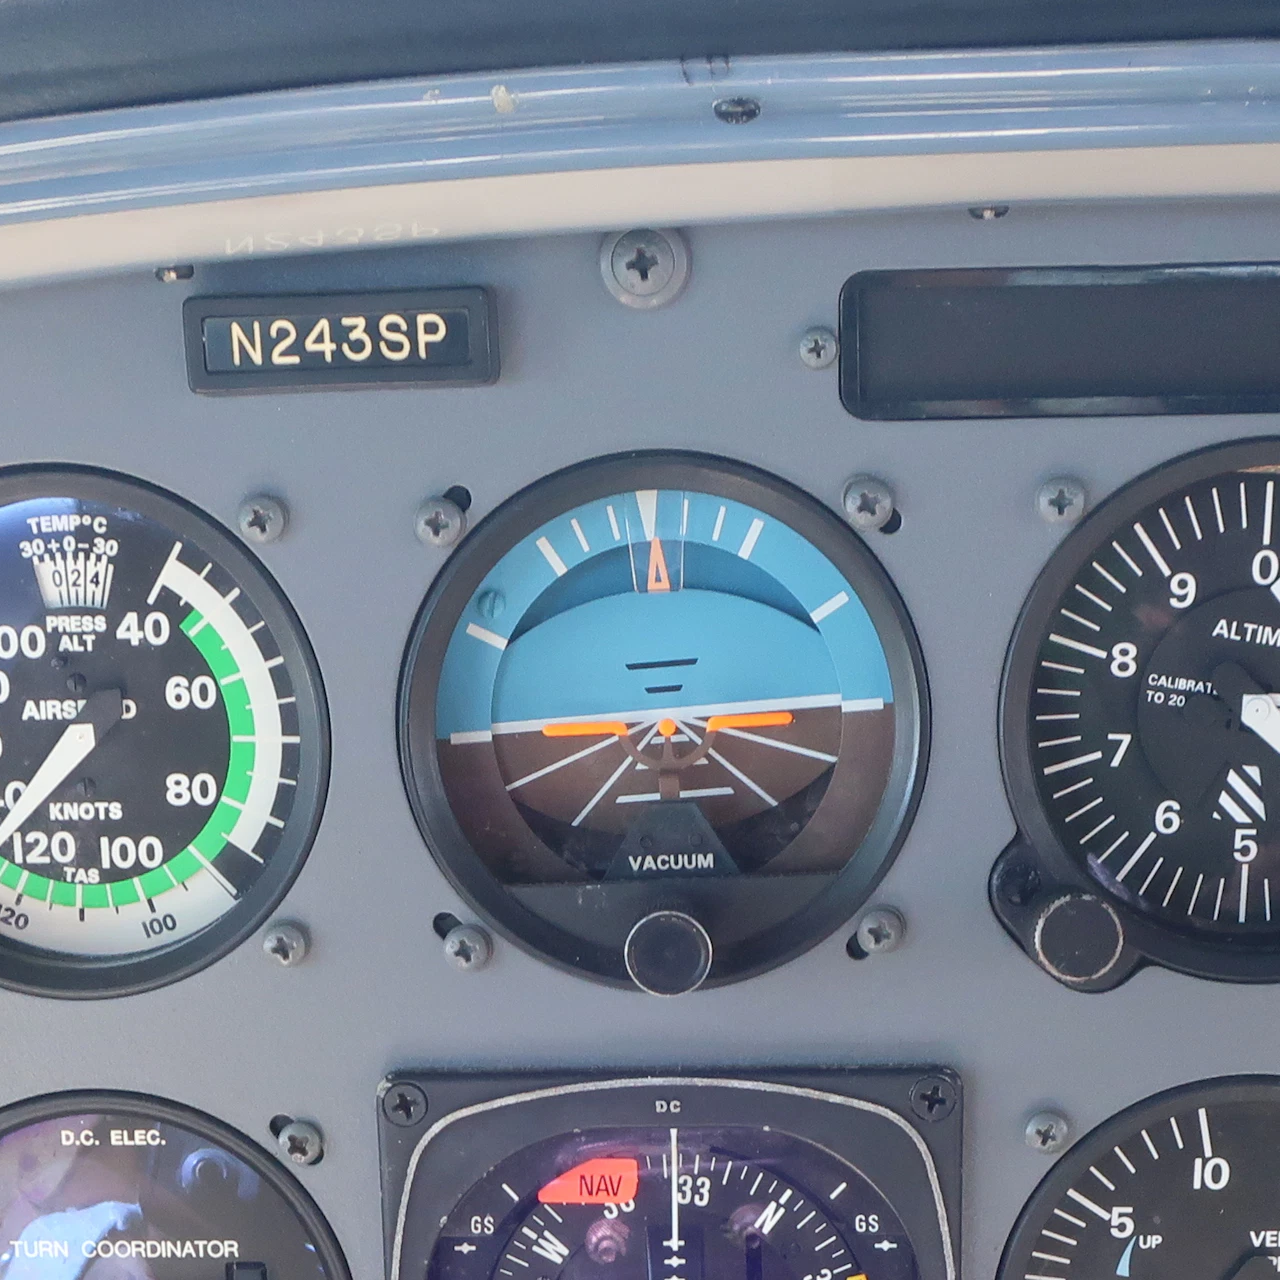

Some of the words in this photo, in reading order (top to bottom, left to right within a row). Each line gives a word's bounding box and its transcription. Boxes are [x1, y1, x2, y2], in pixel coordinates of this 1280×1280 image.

[231, 314, 446, 365] N243SP
[46, 615, 106, 632] PRESS
[116, 612, 169, 646] 40
[59, 635, 95, 651] ALT
[166, 676, 216, 709] 60
[166, 773, 216, 806] 80
[50, 802, 122, 820] KNOTS
[629, 853, 713, 871] VACUUM
[65, 867, 99, 883] TAS
[61, 1130, 99, 1145] D.C.
[111, 1130, 166, 1145] ELEC.
[580, 1175, 621, 1196] NAV
[471, 1216, 494, 1234] GS
[856, 1215, 878, 1232] GS
[10, 1241, 68, 1258] TURN
[81, 1240, 239, 1258] COORDINATOR
[1139, 1235, 1162, 1249] UP
